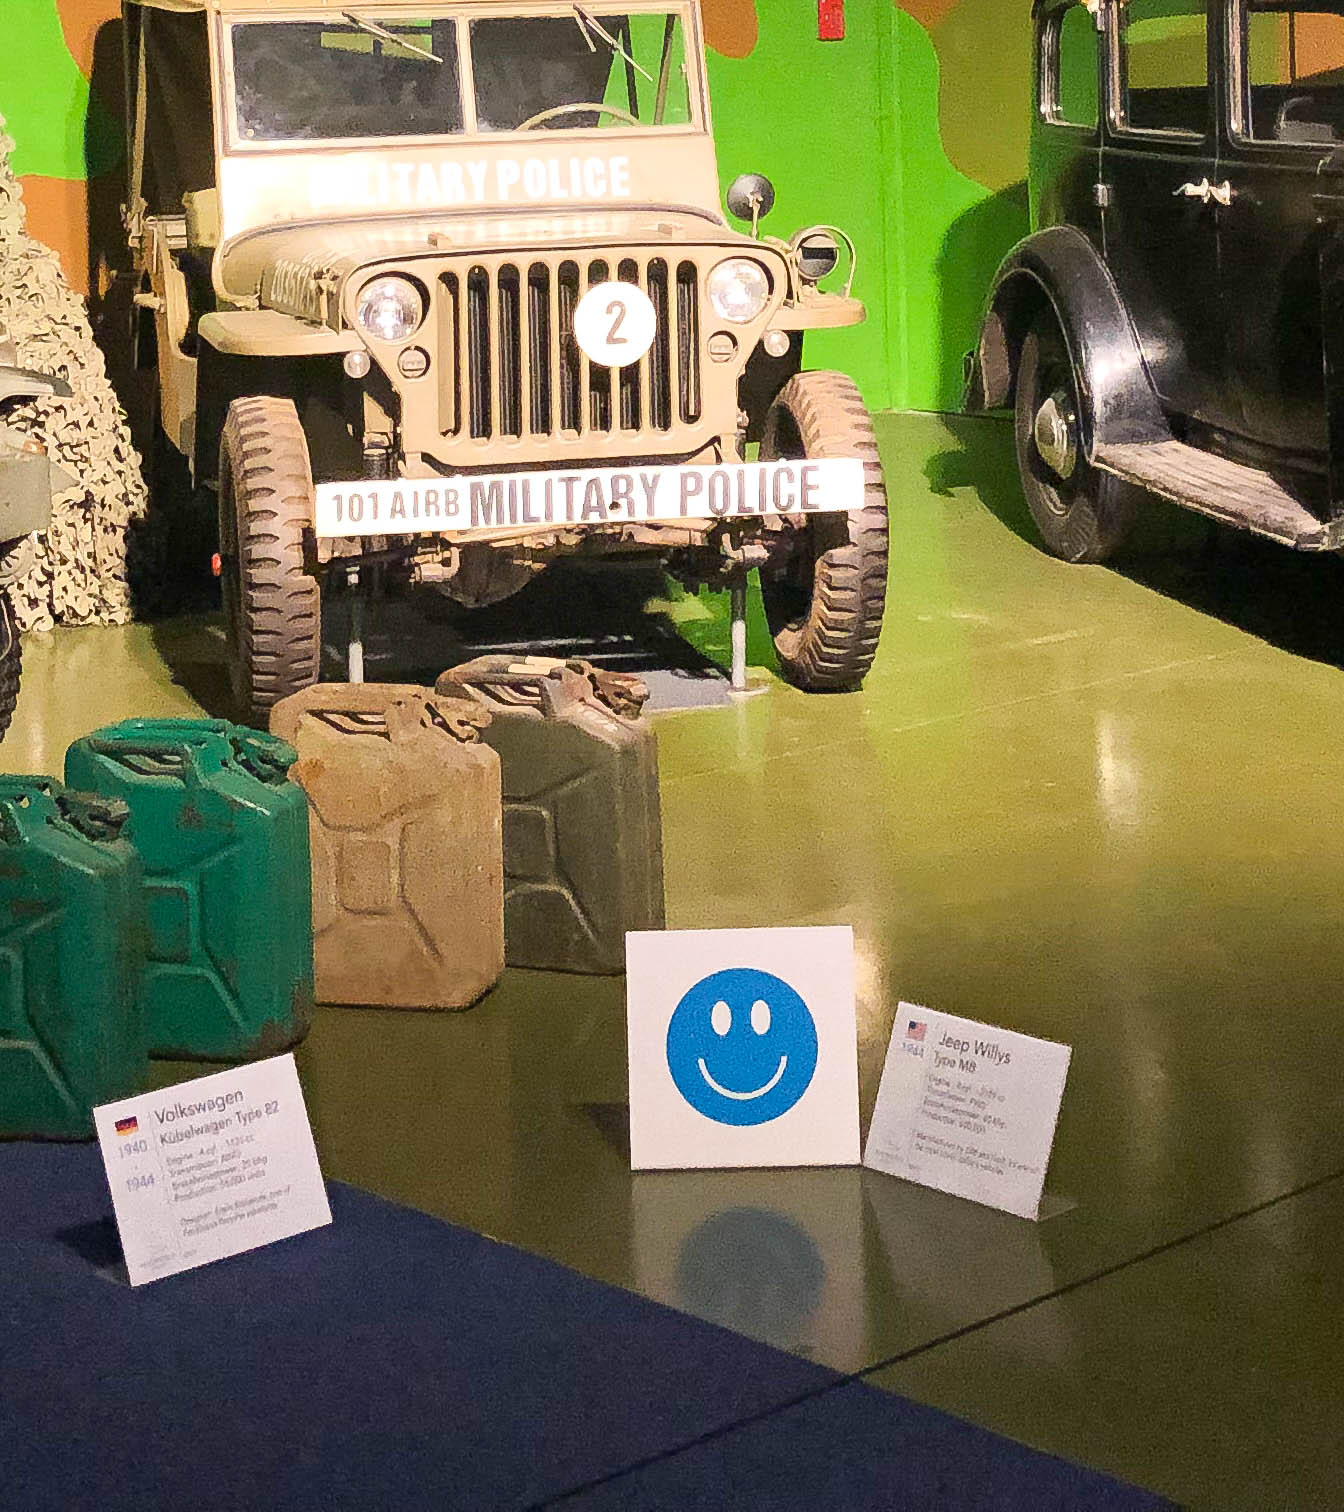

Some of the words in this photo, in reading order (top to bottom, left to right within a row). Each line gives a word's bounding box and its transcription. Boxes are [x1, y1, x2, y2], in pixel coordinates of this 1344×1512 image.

[311, 159, 488, 207] LITARY
[496, 155, 631, 201] POLICE
[604, 299, 628, 346] 2
[332, 491, 379, 522] 101
[390, 488, 460, 520] AIRB
[469, 472, 661, 527] MILITARY
[679, 464, 820, 517] POLICE
[938, 1032, 970, 1054] Jeep
[973, 1039, 1012, 1066] Willys
[155, 1089, 245, 1125] Volkswagen
[234, 1108, 263, 1125] Type
[118, 1138, 148, 1160] 1940
